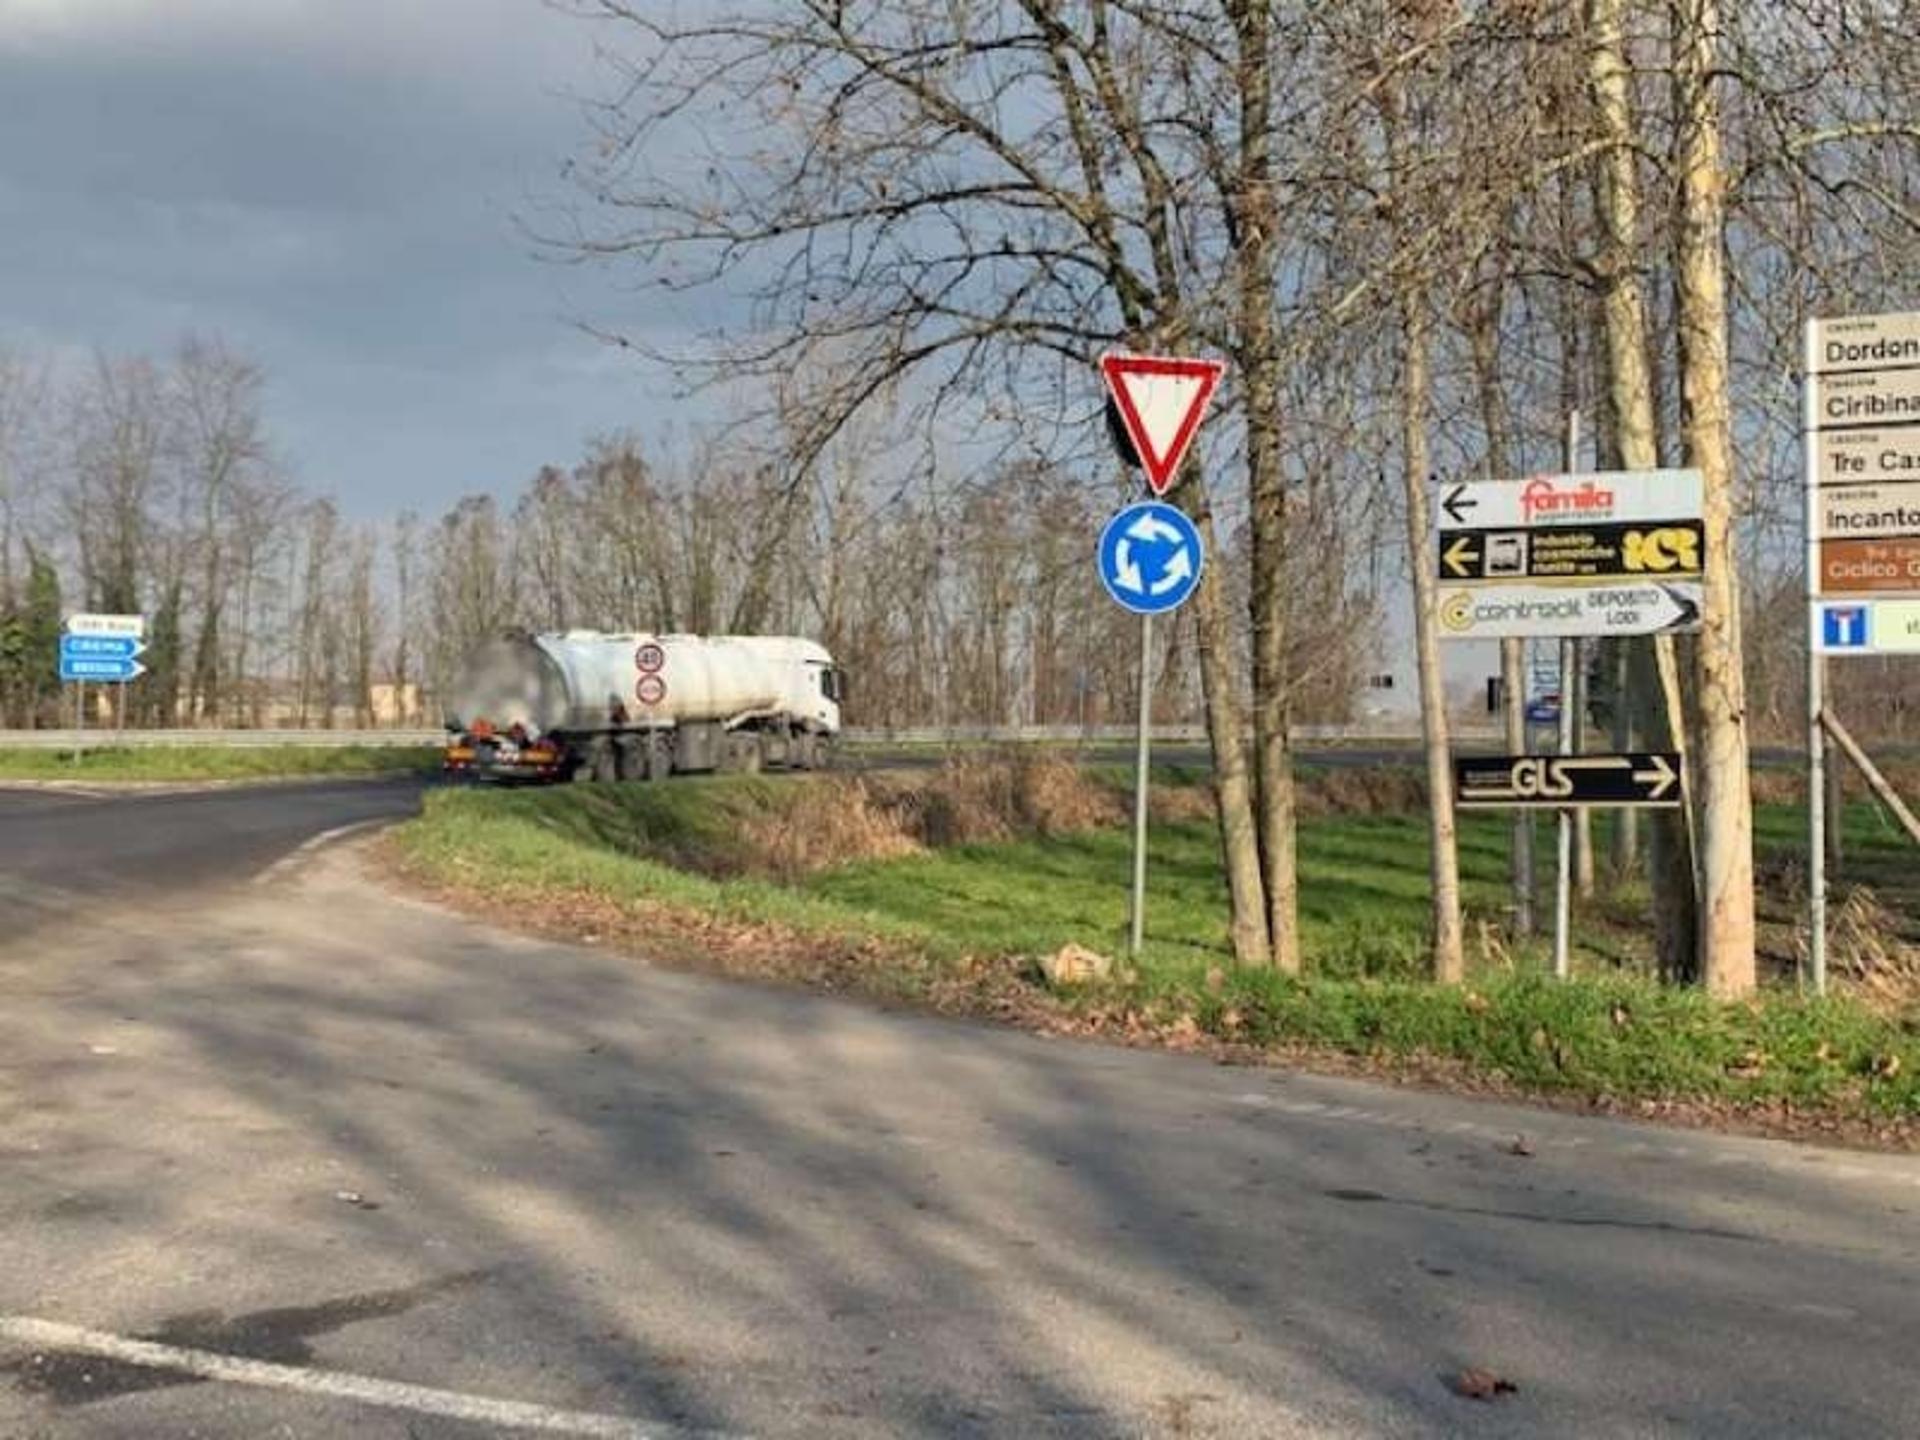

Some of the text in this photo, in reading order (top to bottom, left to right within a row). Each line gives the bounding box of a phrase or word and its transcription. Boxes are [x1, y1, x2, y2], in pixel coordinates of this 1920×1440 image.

[1826, 338, 1919, 363] Dordon
[1829, 449, 1920, 473] Tre Ca
[1520, 480, 1614, 521] famila
[1827, 507, 1920, 530] Incanto
[1511, 757, 1574, 797] GLS
